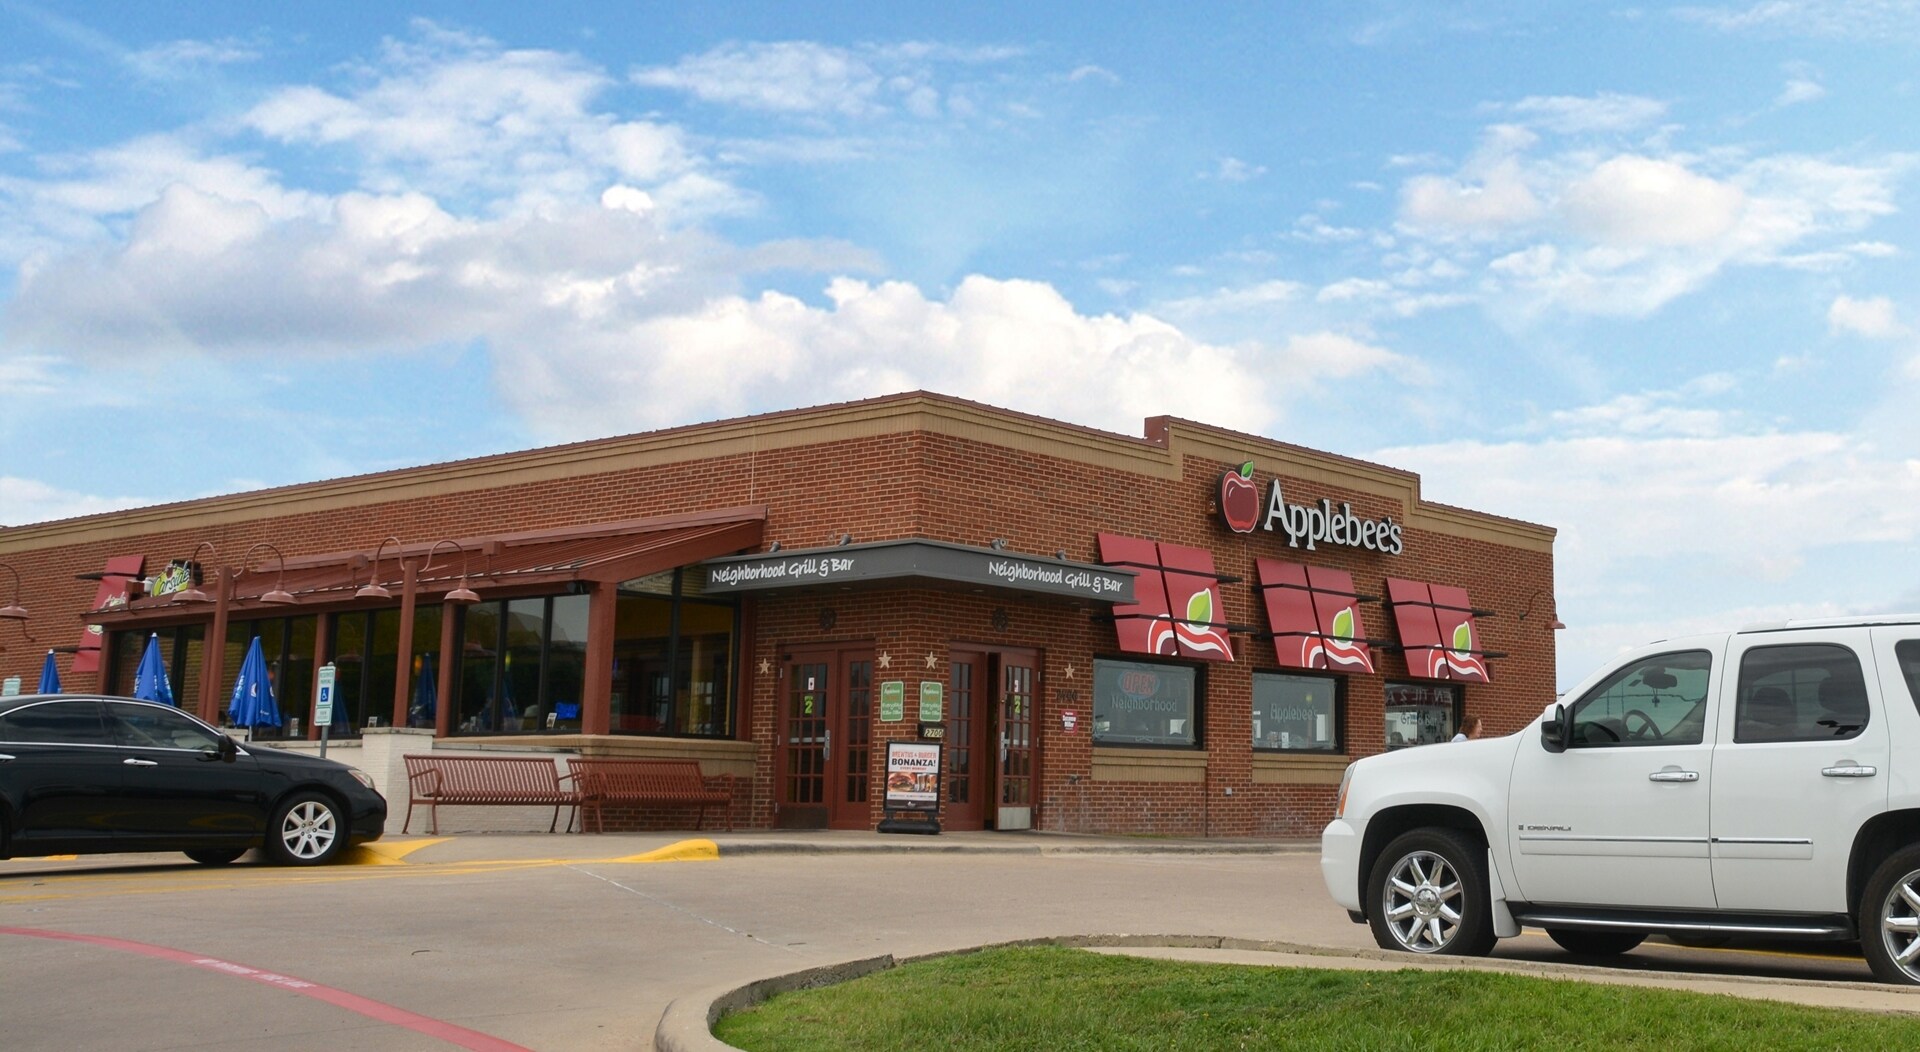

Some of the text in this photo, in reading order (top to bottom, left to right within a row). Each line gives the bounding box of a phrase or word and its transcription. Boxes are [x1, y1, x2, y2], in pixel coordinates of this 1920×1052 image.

[1264, 478, 1404, 556] Applebee's
[153, 561, 190, 593] Carside
[712, 557, 854, 586] Neighborhood Grill & Bar
[988, 561, 1123, 593] Neighborhood Grill & Bar
[1123, 671, 1156, 696] OPEN
[1111, 694, 1177, 713] Neighborhood
[1270, 703, 1318, 724] Applebee's
[925, 728, 944, 738] 2700
[891, 758, 936, 767] BONANZA!
[1527, 824, 1572, 832] DENALI
